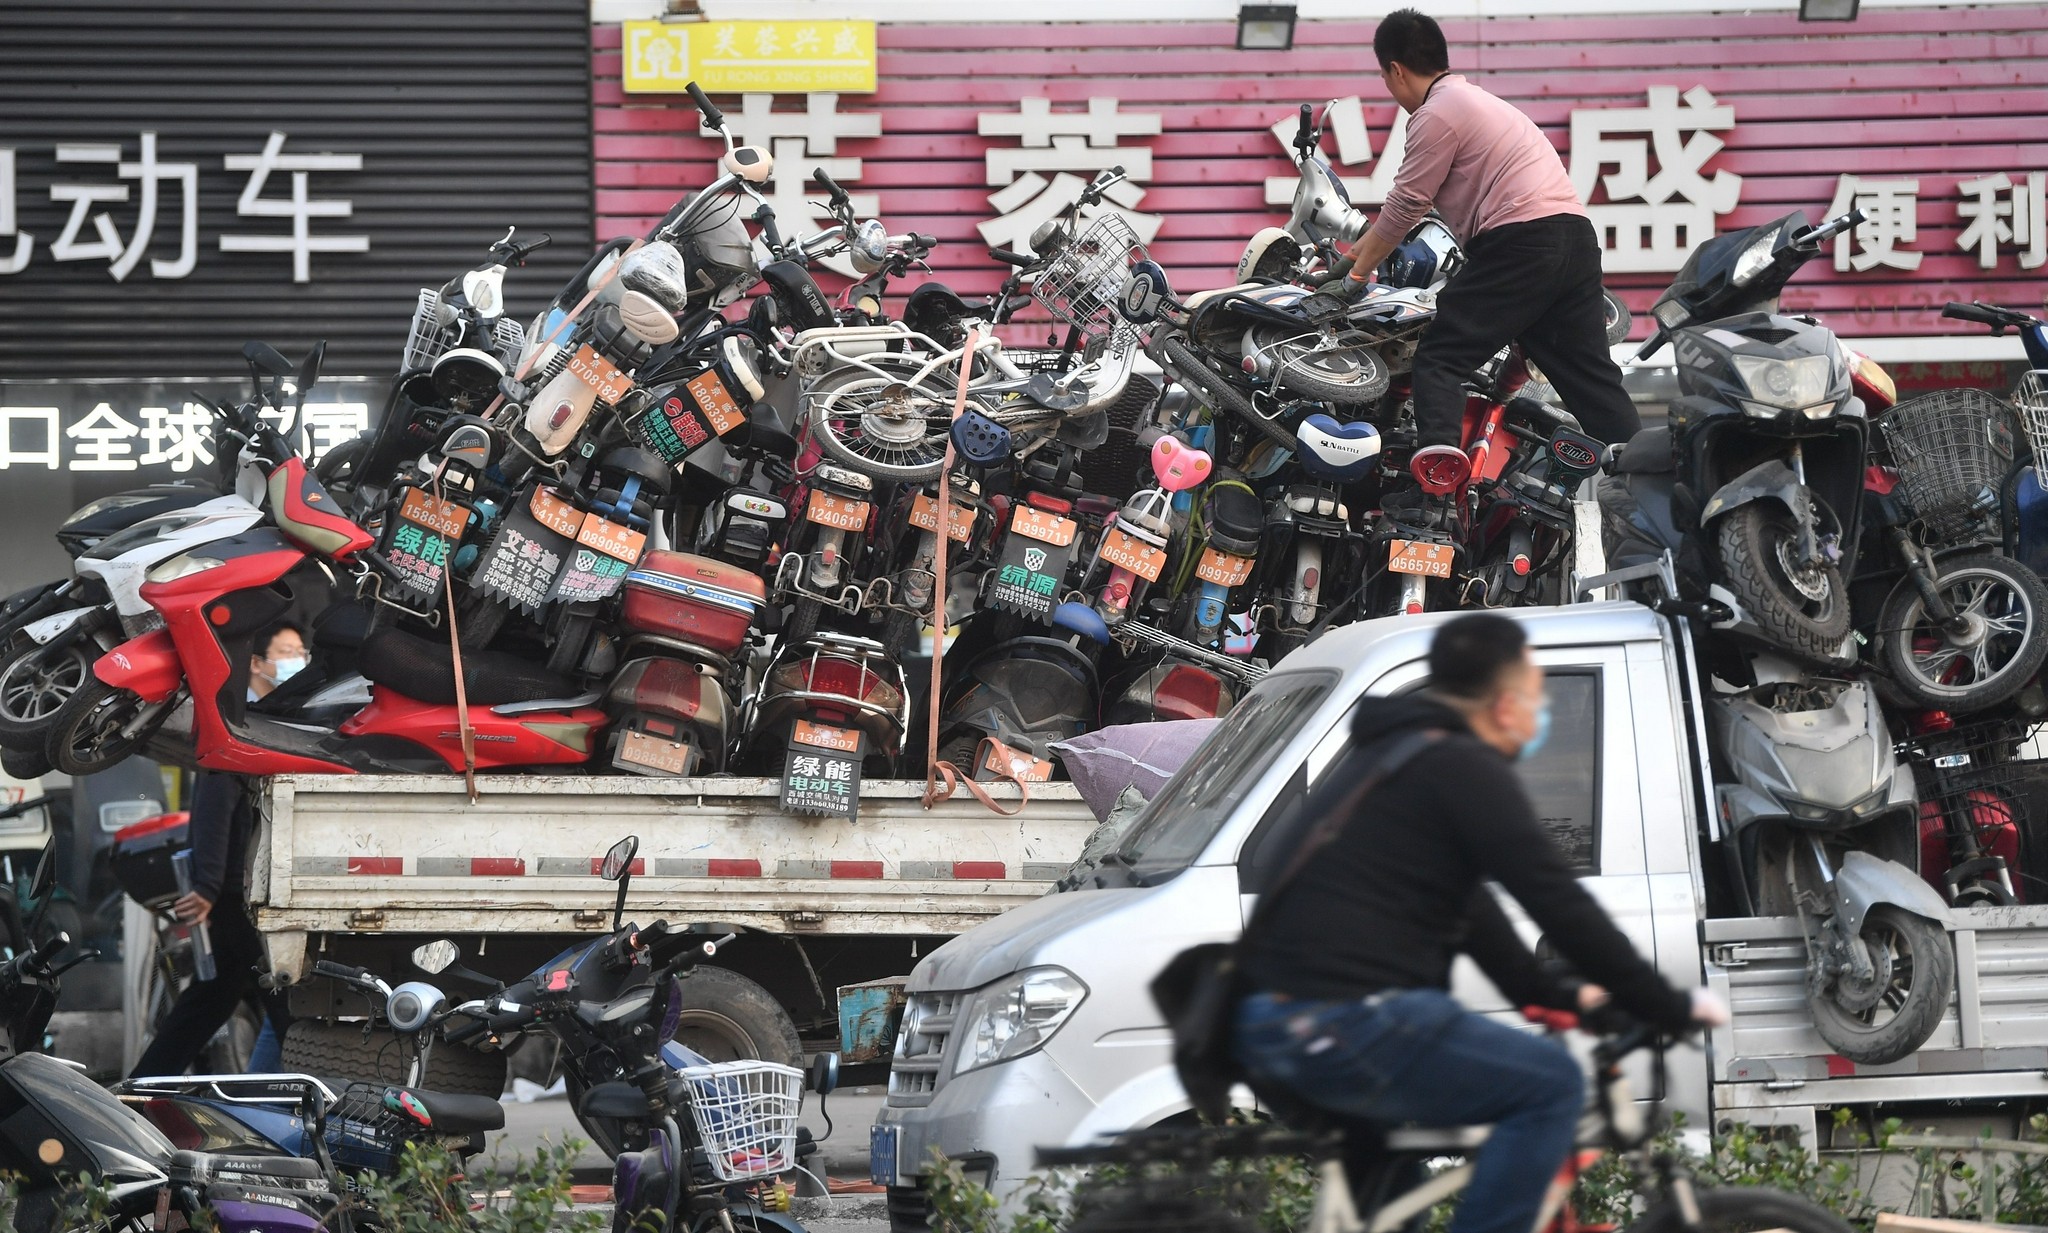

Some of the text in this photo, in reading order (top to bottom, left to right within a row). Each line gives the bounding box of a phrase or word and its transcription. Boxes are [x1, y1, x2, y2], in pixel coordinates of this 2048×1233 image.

[713, 24, 864, 58] 芙蓉兴盛
[704, 70, 865, 83] FU RONG XING SHENG
[570, 358, 619, 402] 0708182
[691, 381, 729, 431] 1808339
[1337, 445, 1360, 454] BATTLE
[530, 498, 576, 535] 1641139
[810, 506, 863, 529] 1240610
[393, 524, 451, 566] 绿能
[1016, 520, 1069, 545] 1399711
[581, 530, 637, 561] 0890826
[386, 548, 443, 581] 尤氏车业
[490, 557, 515, 575] 电动车
[592, 555, 628, 577] 绿源
[1104, 545, 1158, 578] 0693475
[1392, 556, 1448, 575] 0565792
[483, 574, 541, 609] 010-60593150
[999, 564, 1058, 596] 绿源
[799, 732, 854, 749] 1305907
[625, 747, 681, 771] 0988475
[792, 755, 852, 780] 绿能
[789, 776, 852, 796] 电动车
